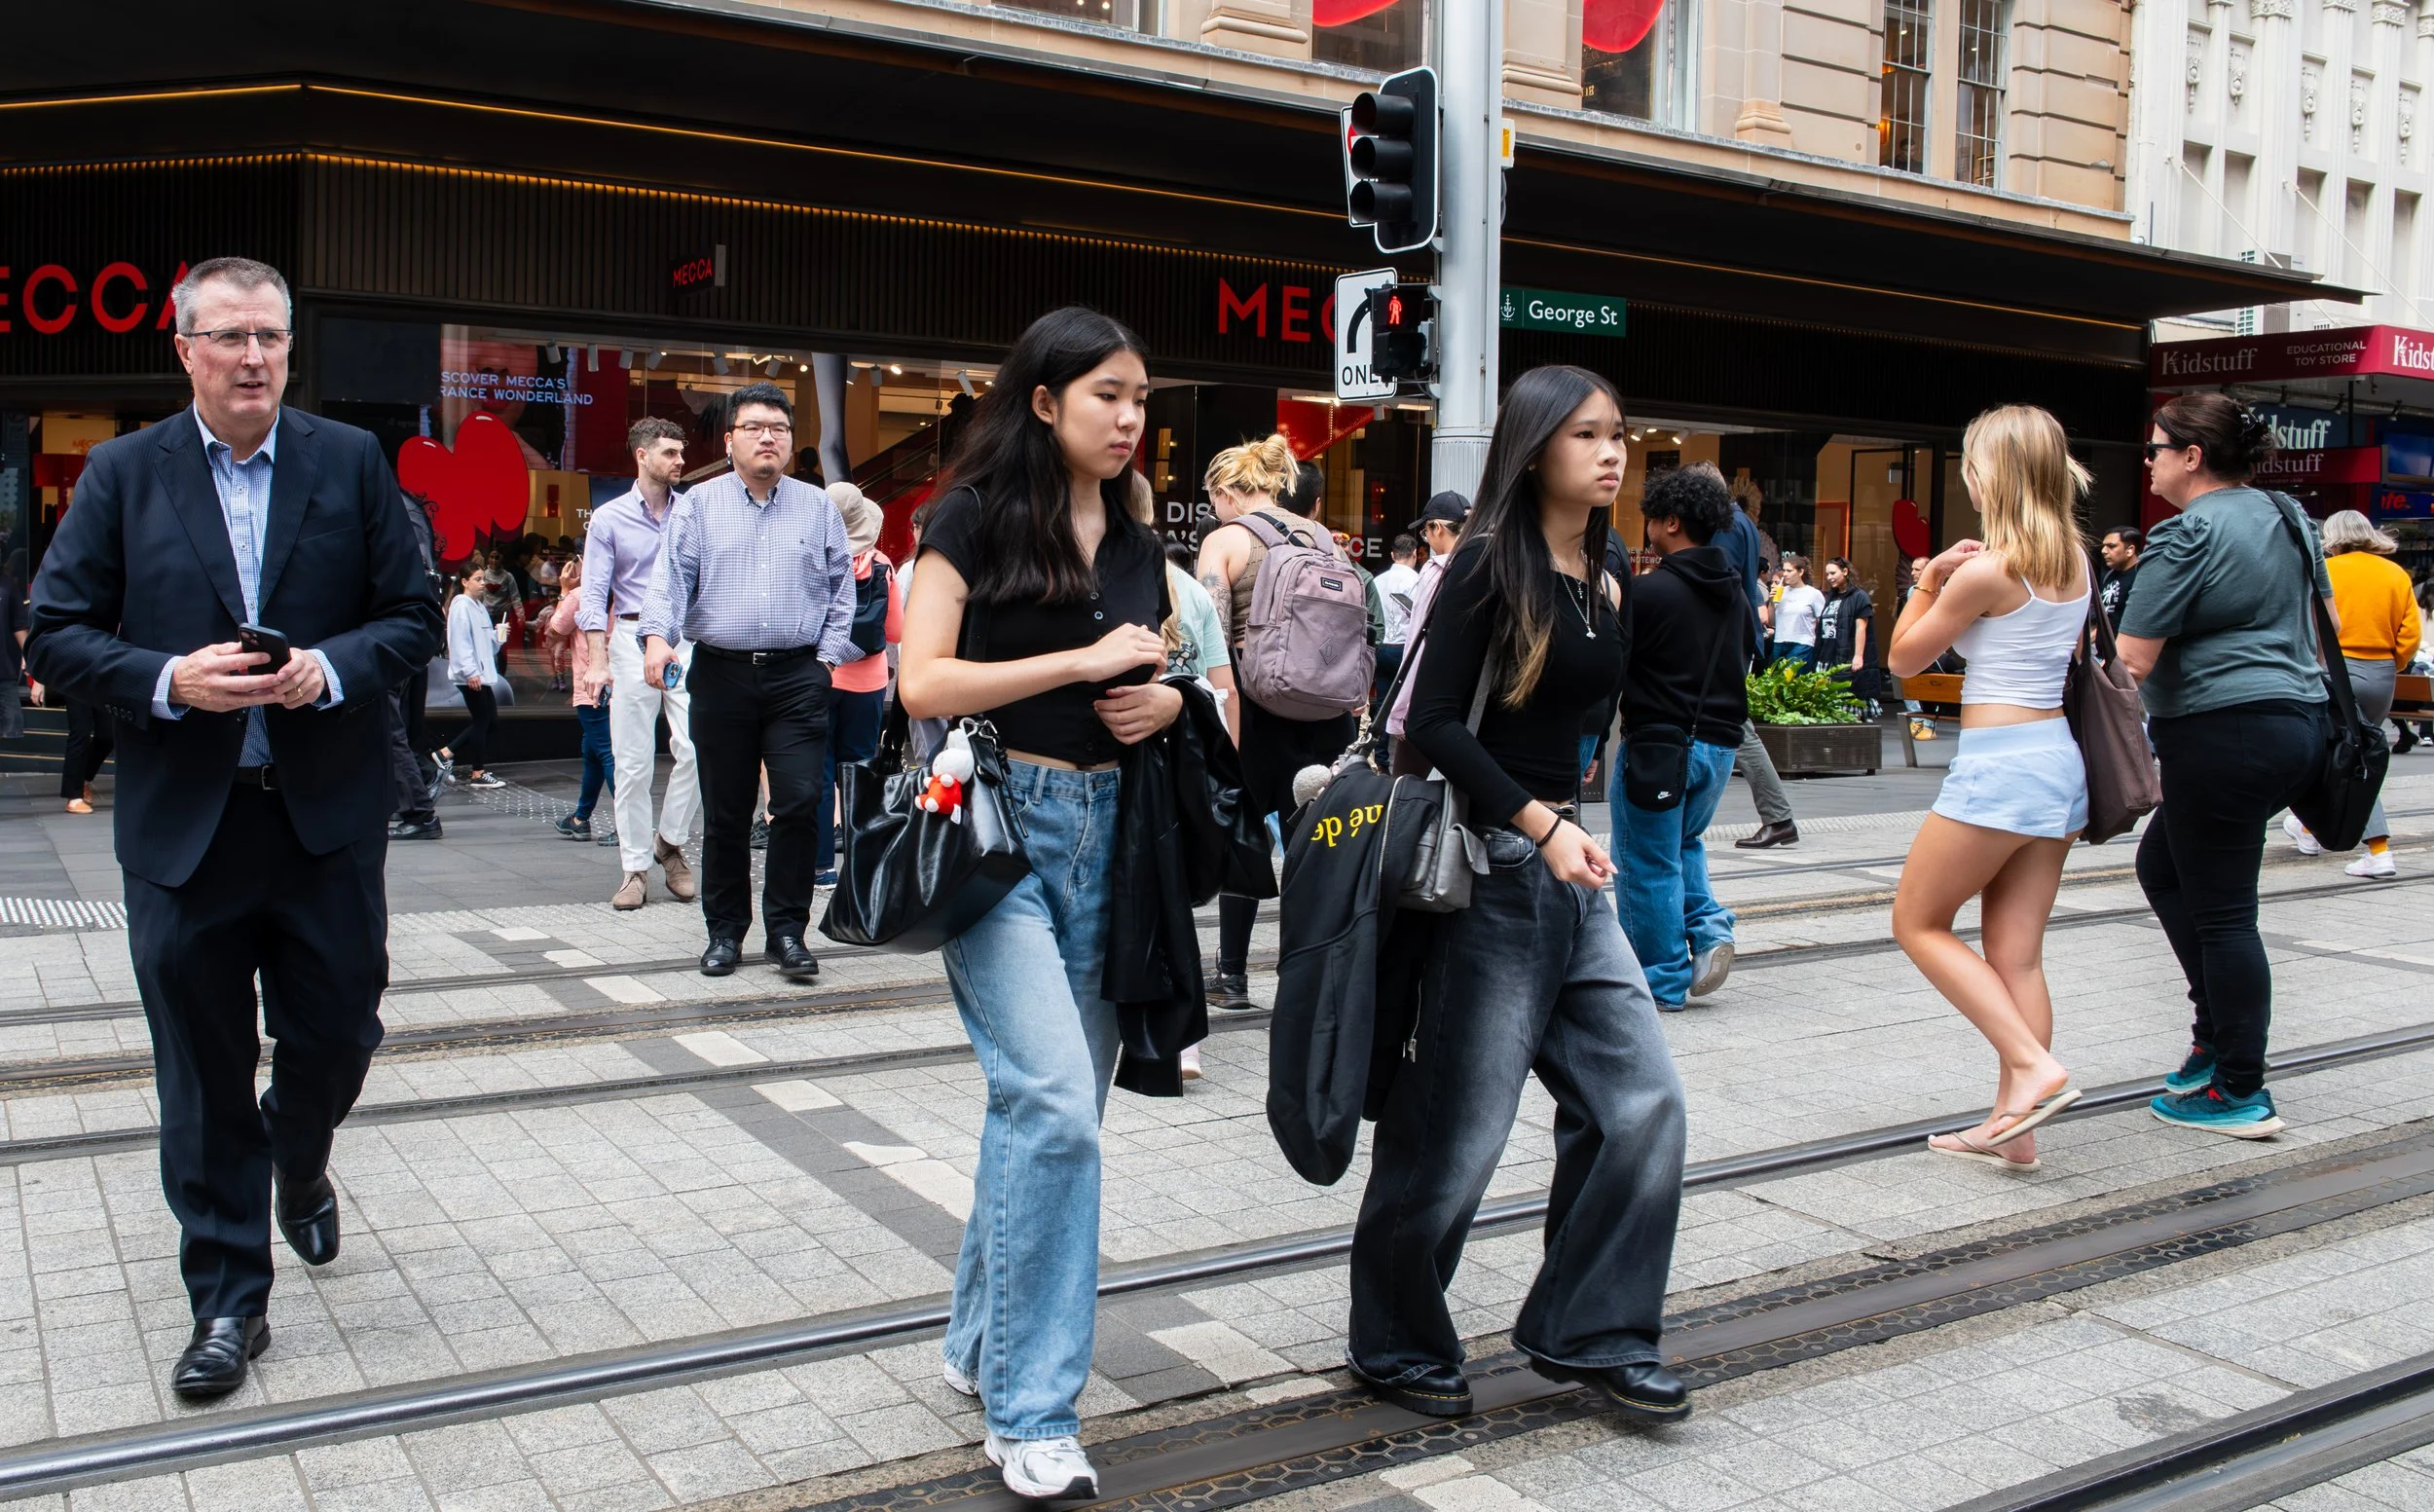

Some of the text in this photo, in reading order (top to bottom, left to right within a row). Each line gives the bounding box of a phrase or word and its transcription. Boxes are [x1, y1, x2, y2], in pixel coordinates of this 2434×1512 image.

[673, 257, 713, 288] MECCA
[1218, 277, 1335, 343] ME
[1529, 300, 1618, 328] George St
[2286, 341, 2367, 354] EDUCATIONAL
[2161, 348, 2259, 375] Kidstuff
[2295, 353, 2356, 366] TOY STORE
[441, 372, 566, 389] SCOVER MECCA'S
[495, 389, 593, 405] WONDERLAND
